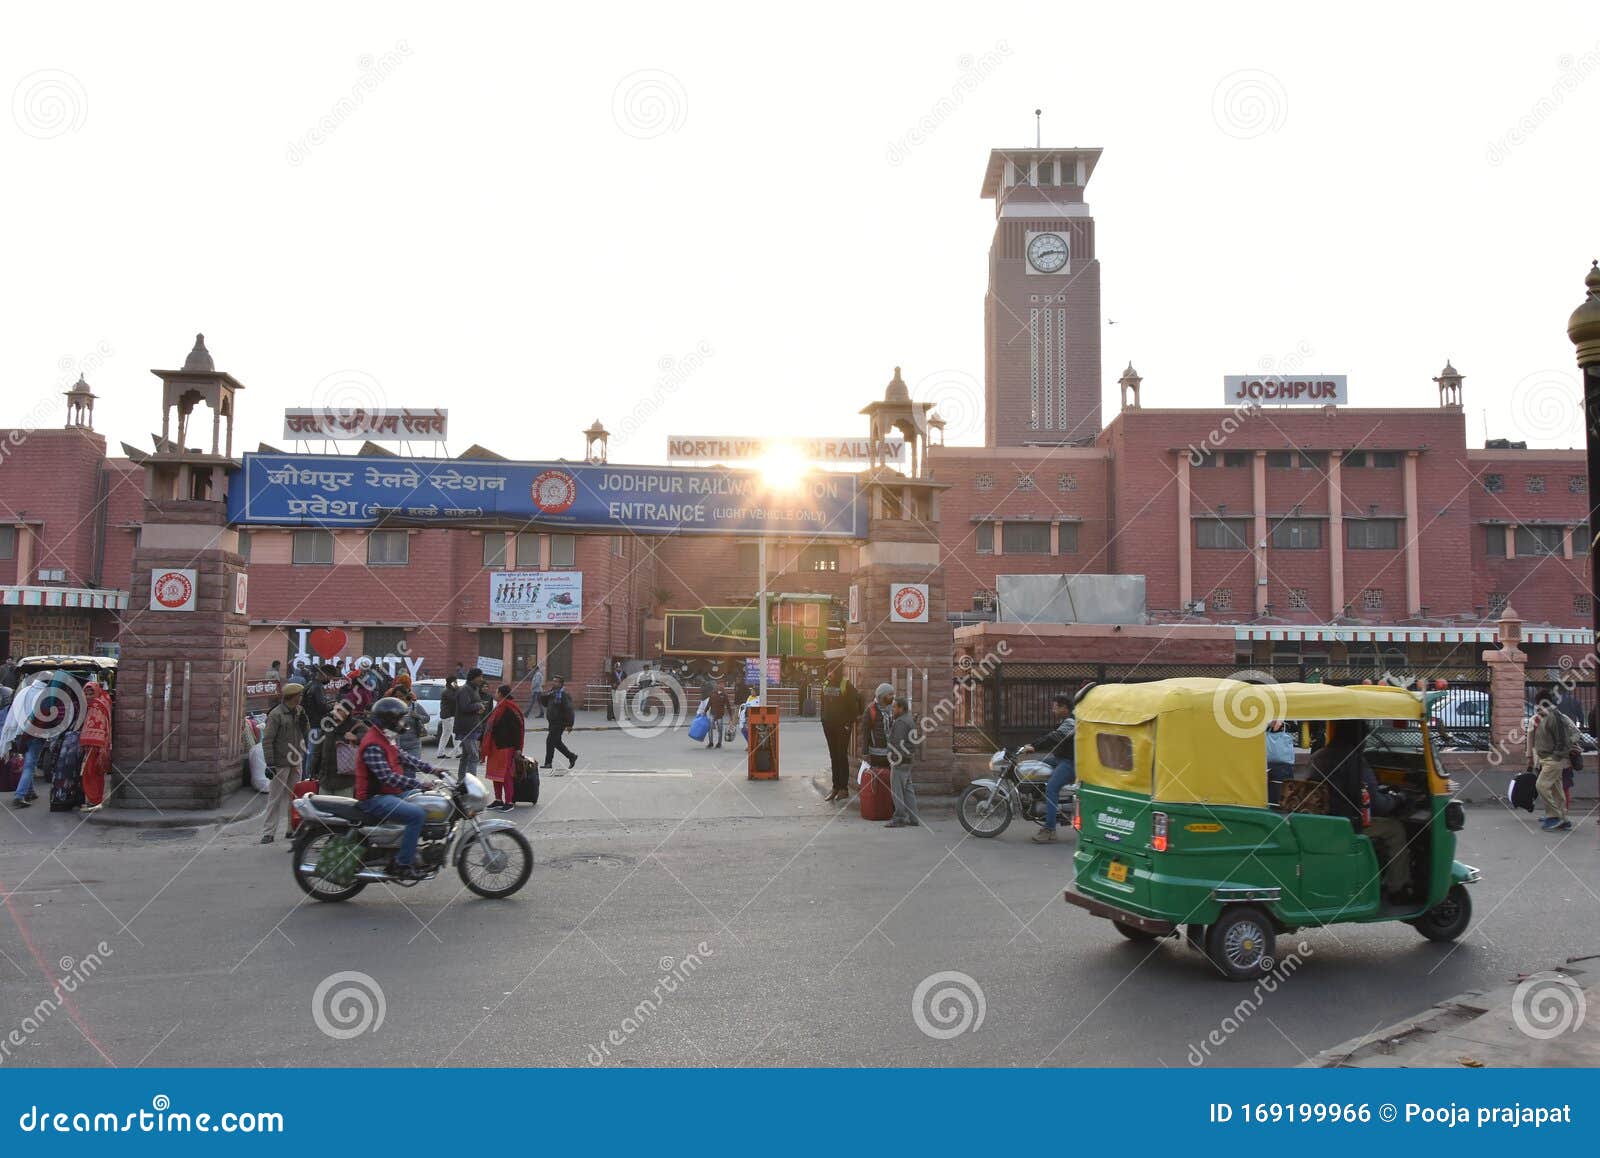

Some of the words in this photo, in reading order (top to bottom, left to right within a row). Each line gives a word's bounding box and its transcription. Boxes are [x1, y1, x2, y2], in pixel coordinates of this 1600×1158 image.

[1236, 381, 1337, 399] JODHPUR
[401, 408, 446, 433] रेलवे
[669, 440, 730, 456] NORTH
[825, 442, 903, 458] RAILWAY
[267, 464, 354, 491] जोधपुर
[365, 466, 420, 488] रेलवे
[430, 469, 507, 491] स्टेशन
[599, 474, 683, 493] JODHPUR
[688, 477, 757, 496] RAILWA
[288, 495, 358, 515] प्रवेश
[609, 502, 705, 521] ENTRANCE
[713, 508, 746, 520] (LIGHT
[750, 509, 793, 520] VEHICLE
[797, 510, 827, 522] ONLY)
